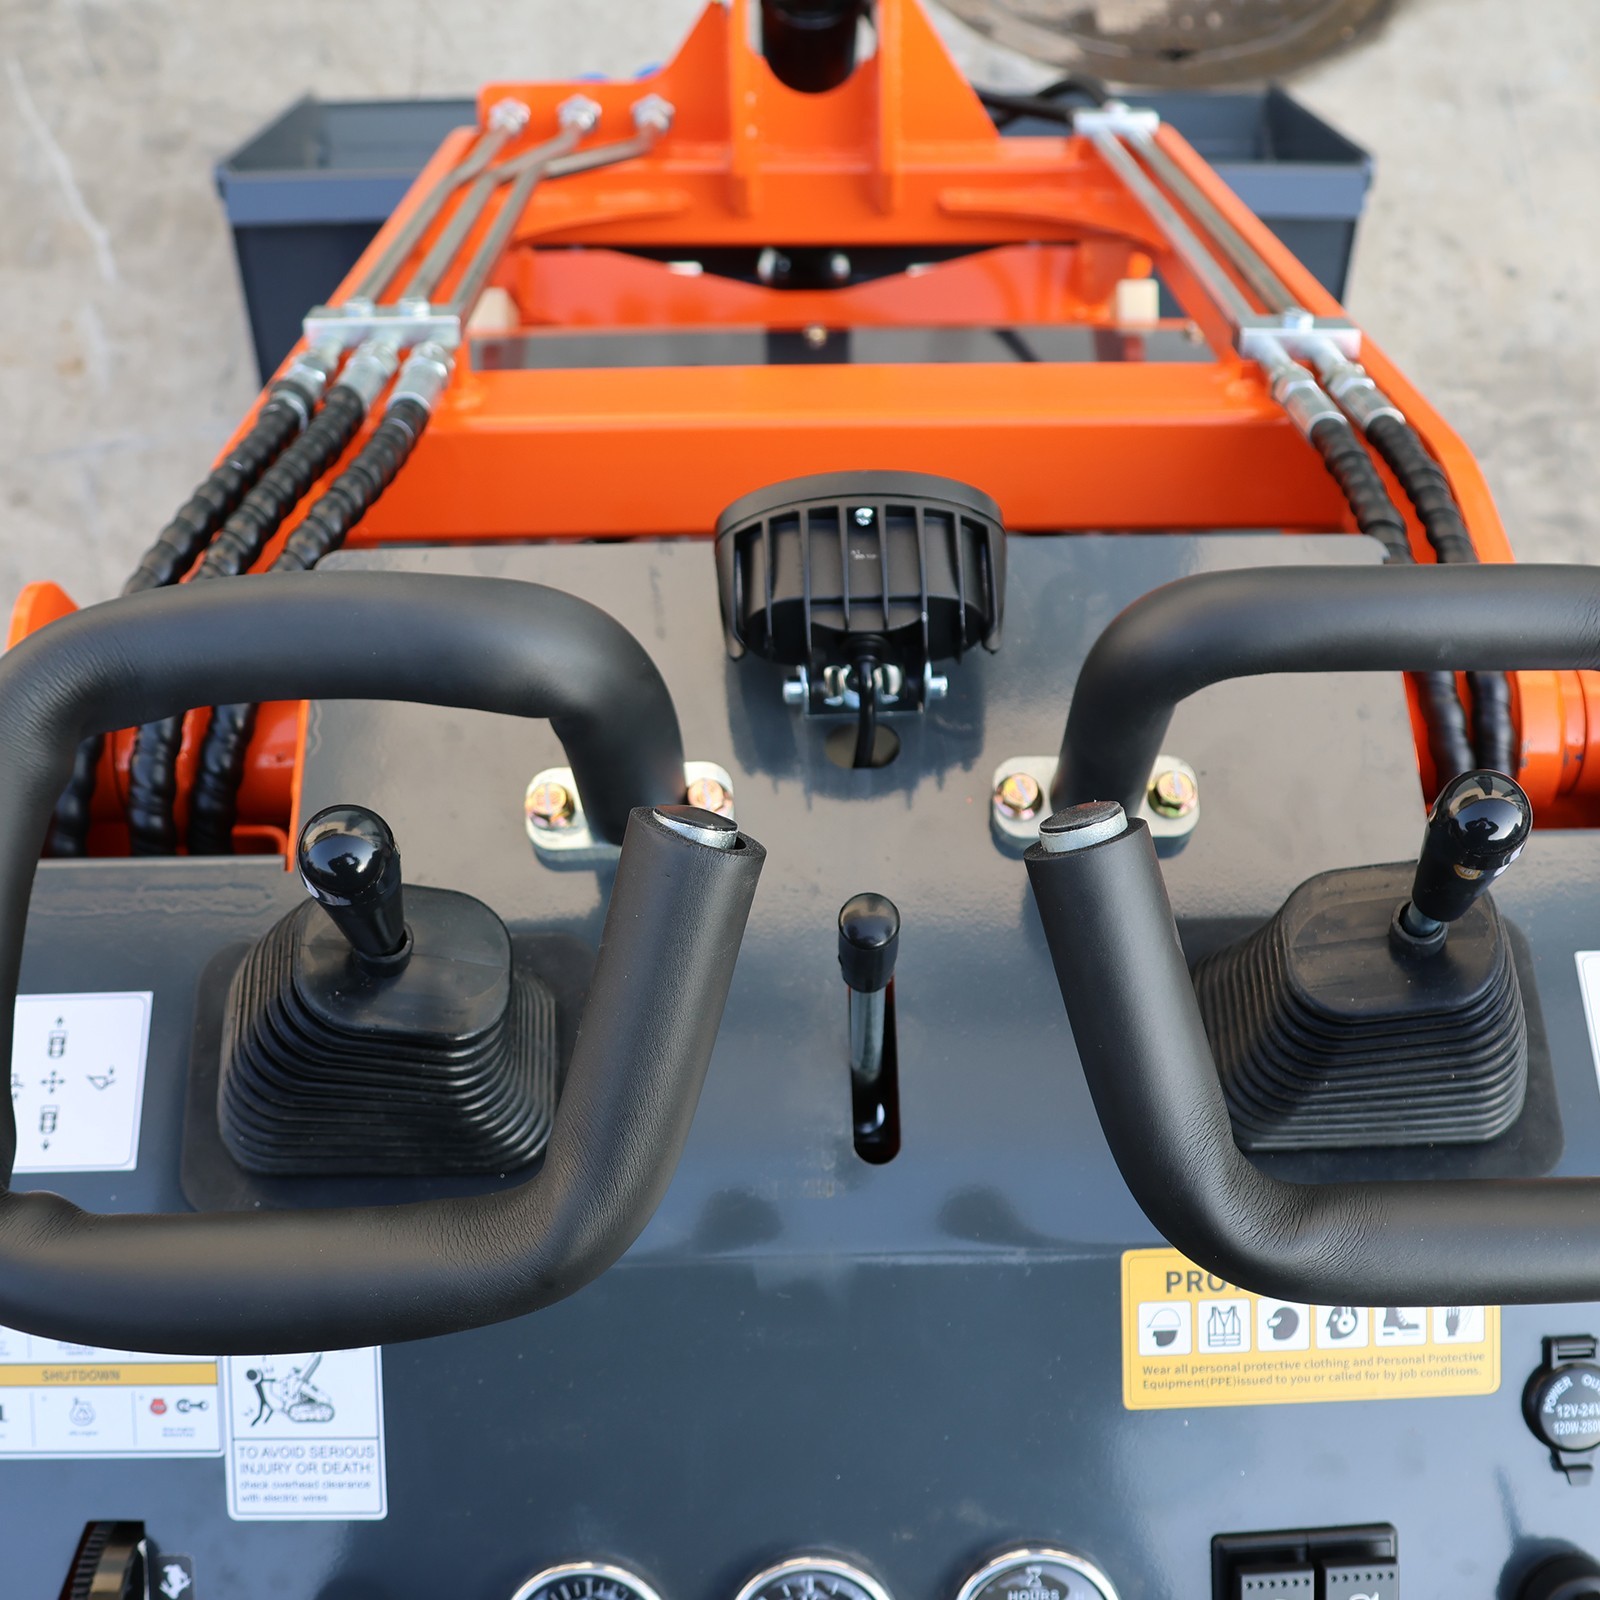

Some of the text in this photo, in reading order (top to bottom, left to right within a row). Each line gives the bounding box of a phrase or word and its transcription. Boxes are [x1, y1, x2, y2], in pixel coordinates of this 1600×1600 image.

[1166, 1271, 1242, 1293] PRO
[1142, 1352, 1486, 1376] Wear all personal protective clothing and Personal Protective
[41, 1369, 121, 1382] SHUTDOWN
[1276, 1376, 1288, 1385] to
[1290, 1375, 1311, 1386] you
[1314, 1374, 1326, 1383] or
[1328, 1370, 1362, 1382] called
[1365, 1369, 1381, 1380] for
[1384, 1368, 1396, 1382] by
[1399, 1368, 1417, 1382] job
[1420, 1366, 1482, 1378] conditions.
[1543, 1376, 1573, 1413] POWER
[239, 1445, 375, 1459] TO AVOID SERIOUS
[240, 1461, 291, 1475] INJURY
[295, 1461, 319, 1475] OR
[1008, 1589, 1060, 1600] HOURS
